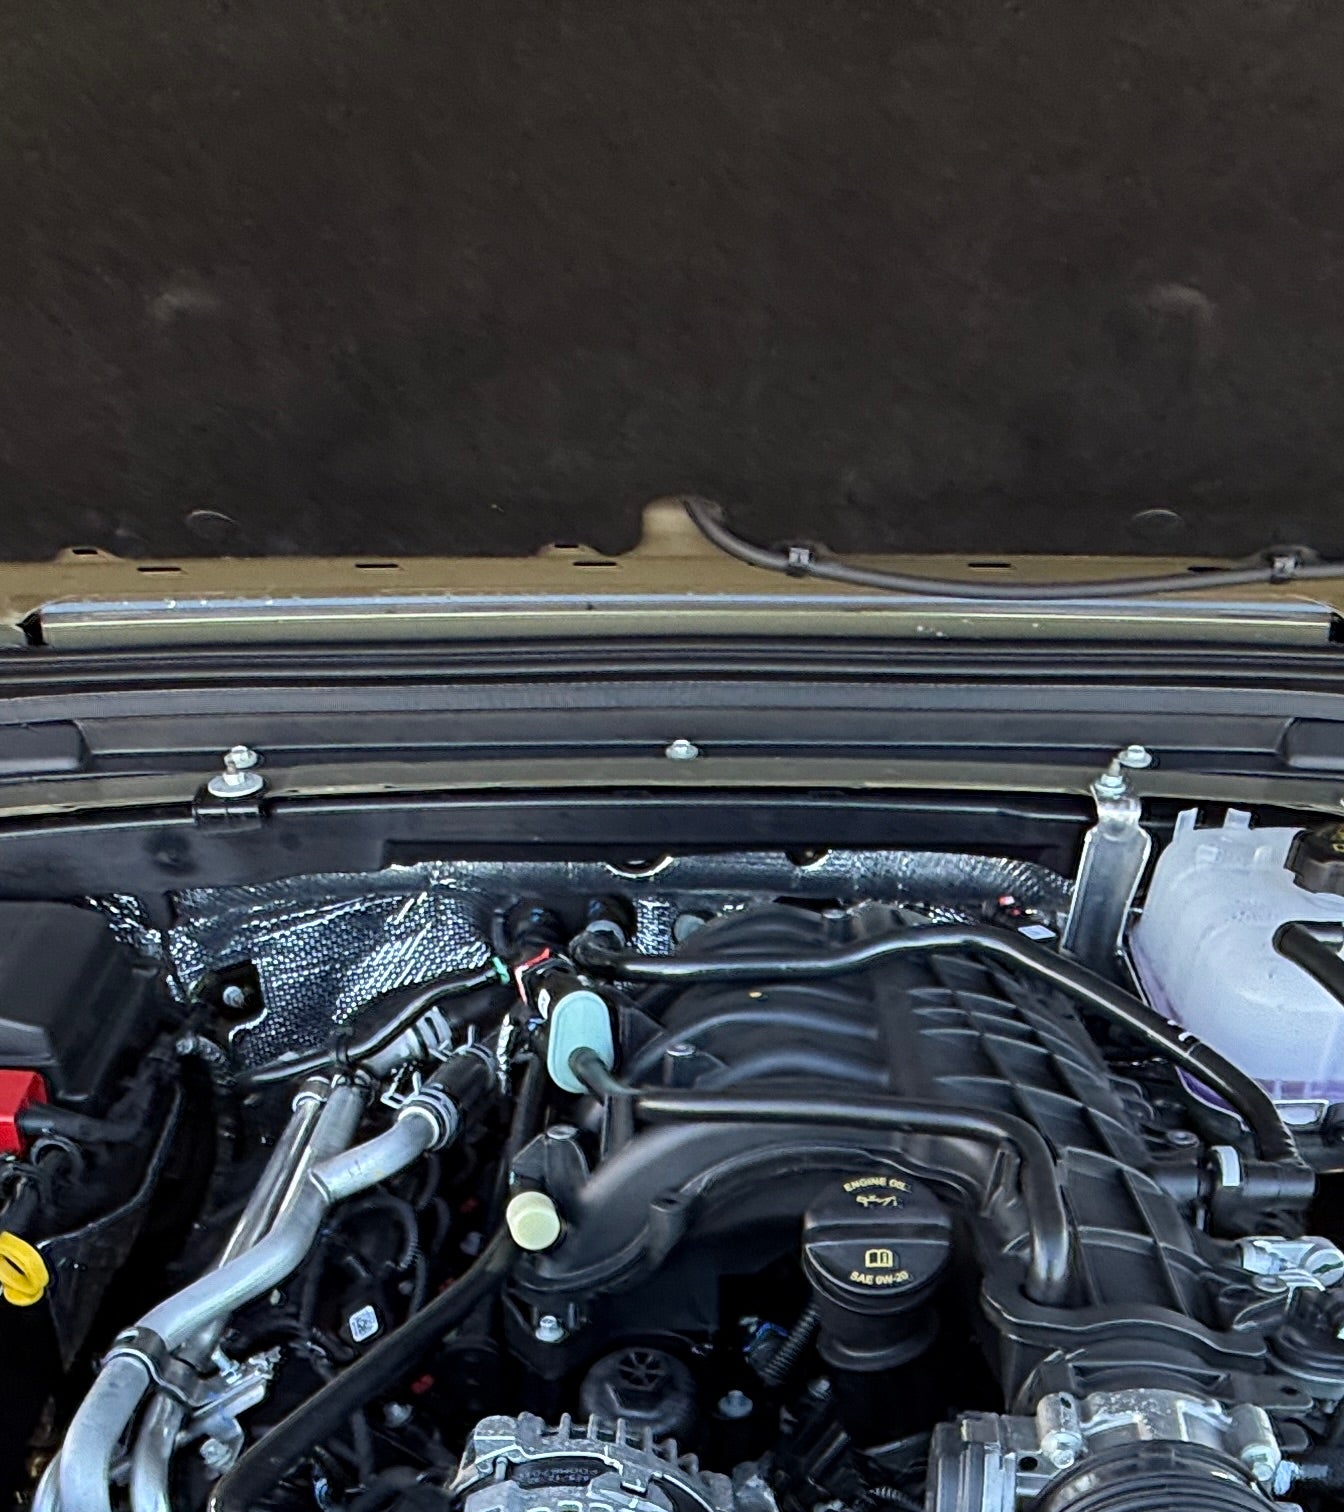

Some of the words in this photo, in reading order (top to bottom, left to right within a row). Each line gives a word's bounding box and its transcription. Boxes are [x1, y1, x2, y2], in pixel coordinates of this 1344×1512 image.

[843, 1176, 887, 1192] ENGINE
[889, 1178, 910, 1193] OIL
[849, 1270, 874, 1286] SAE
[875, 1270, 909, 1286] 0W-20
